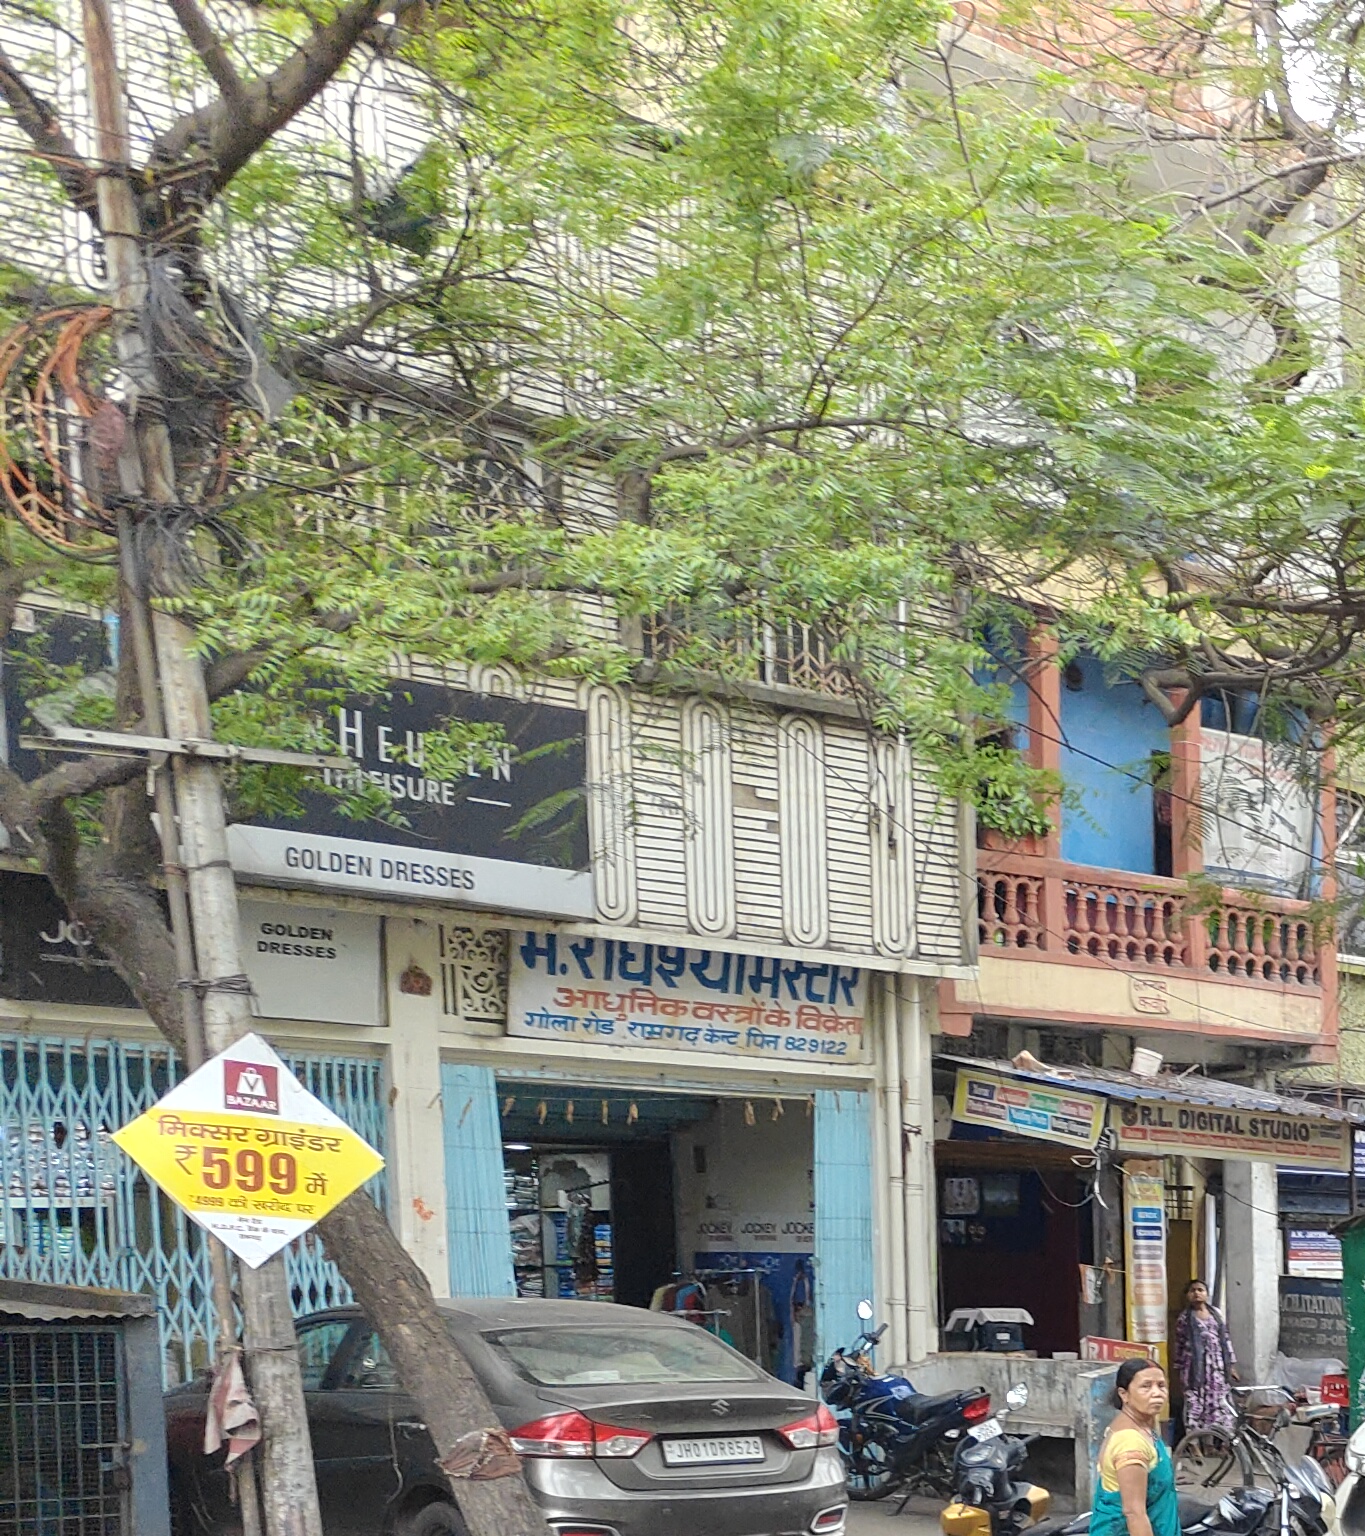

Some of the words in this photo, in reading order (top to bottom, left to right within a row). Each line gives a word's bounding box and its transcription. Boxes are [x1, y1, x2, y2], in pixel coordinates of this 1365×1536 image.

[338, 707, 512, 783] HEUEN
[285, 846, 372, 877] GOLDEN
[381, 858, 475, 891] DRESSES
[261, 922, 333, 942] GOLDEN
[256, 940, 337, 960] DRESSES
[553, 987, 690, 1022] आधुनिक
[524, 1006, 579, 1032] गोला
[582, 1011, 616, 1035] रोड
[745, 1027, 781, 1050] पिन
[784, 1036, 848, 1056] 829122
[226, 1094, 277, 1111] BAZAAR
[157, 1114, 249, 1143] मिक्सर
[255, 1128, 344, 1153] ग्राइंडर
[1178, 1109, 1245, 1136] DIGITAL
[1249, 1116, 1311, 1143] STUDIO
[304, 1172, 329, 1196] में
[296, 1202, 316, 1216] पर
[676, 1439, 762, 1459] JH01DR8529
